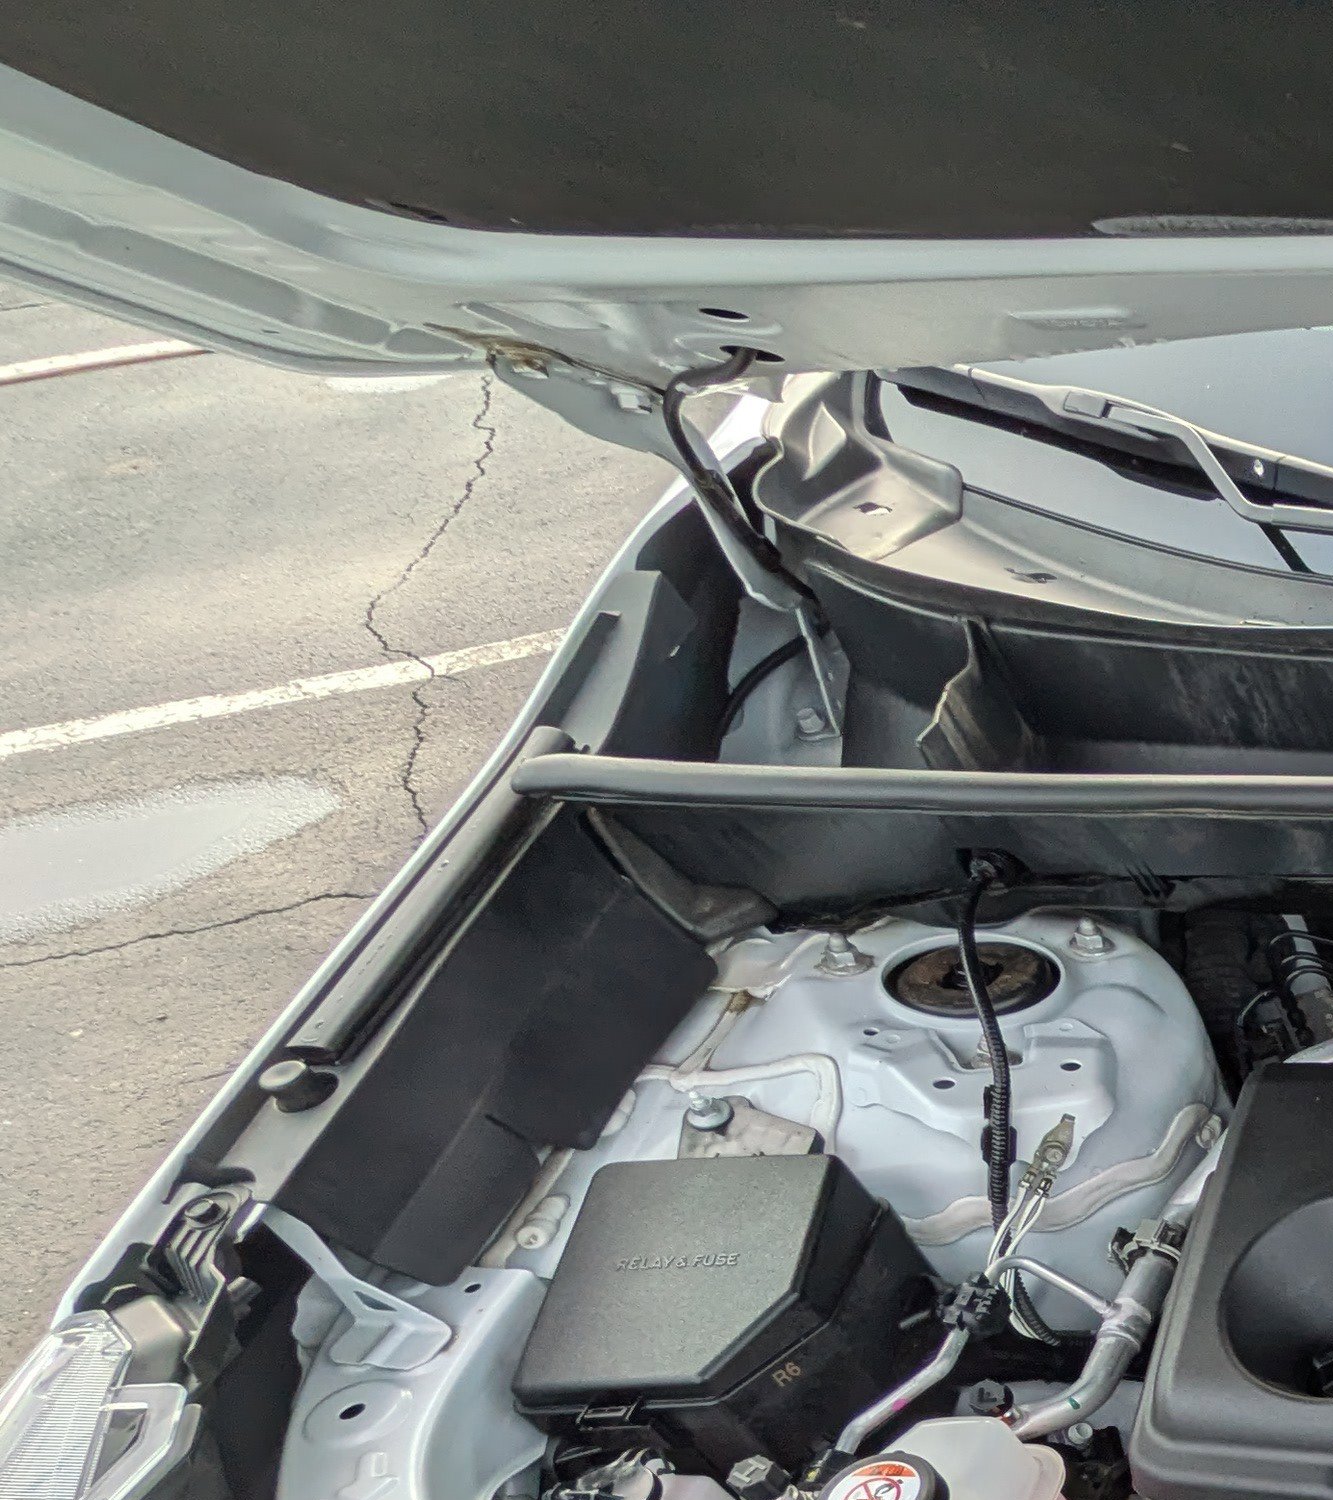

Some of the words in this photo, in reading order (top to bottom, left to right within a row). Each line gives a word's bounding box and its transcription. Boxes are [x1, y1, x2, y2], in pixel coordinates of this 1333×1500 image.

[615, 1255, 675, 1272] RELAY
[675, 1256, 688, 1268] &
[692, 1252, 741, 1268] FUSE
[771, 1361, 801, 1388] R6
